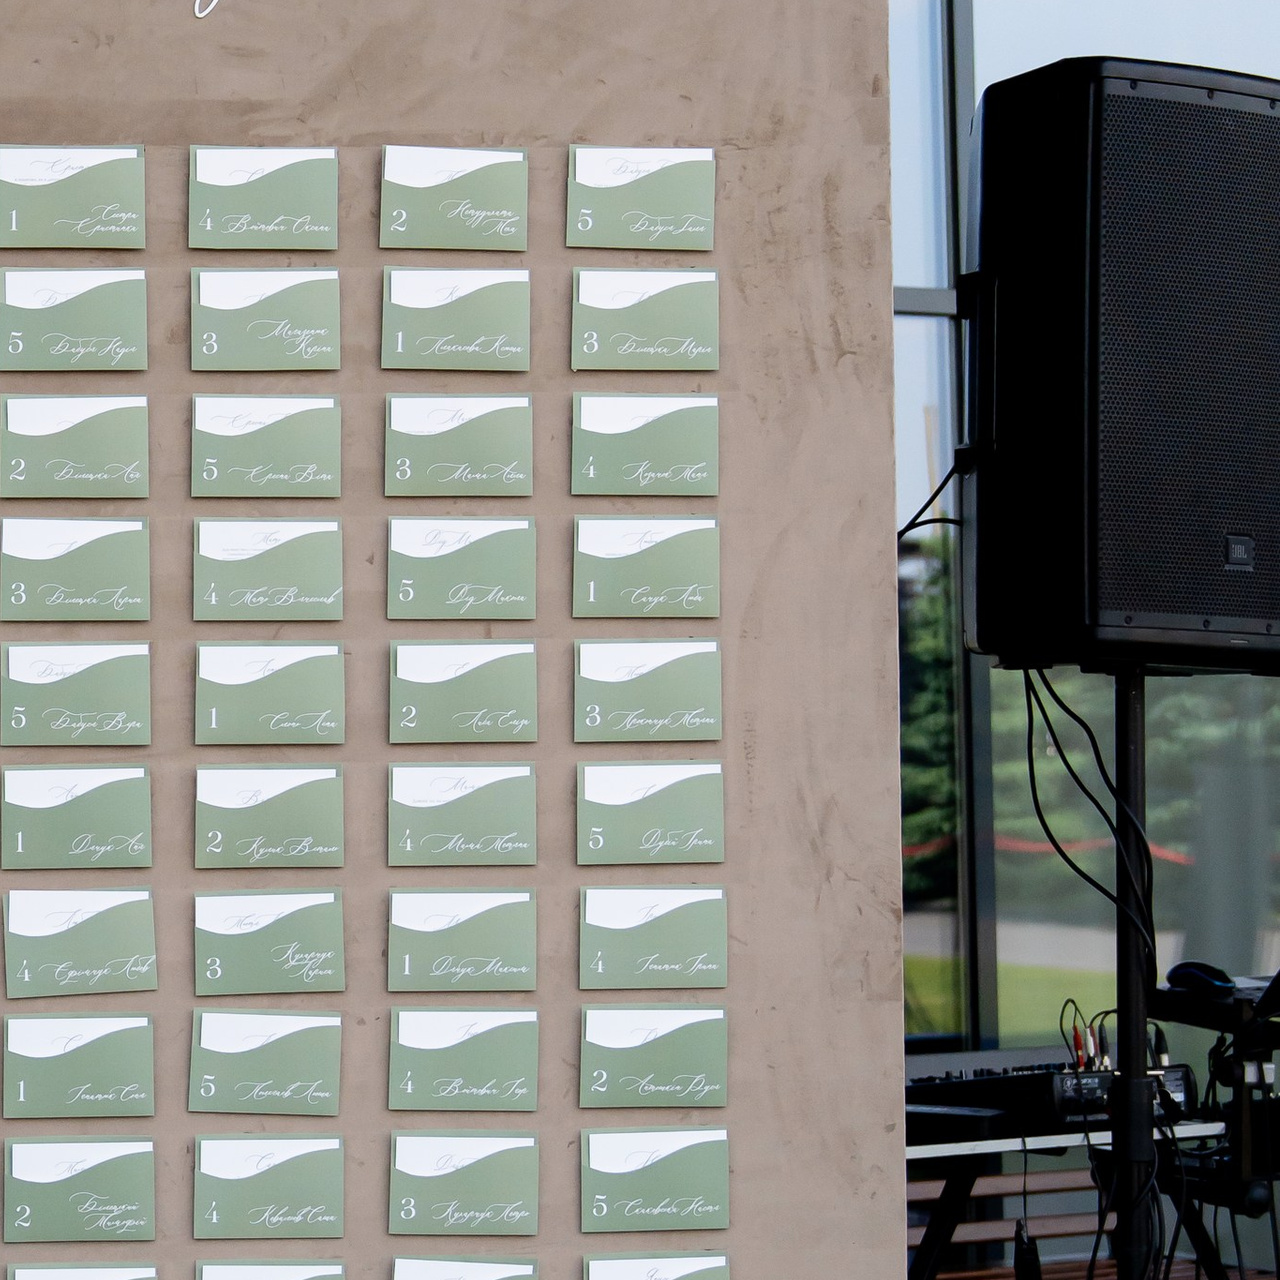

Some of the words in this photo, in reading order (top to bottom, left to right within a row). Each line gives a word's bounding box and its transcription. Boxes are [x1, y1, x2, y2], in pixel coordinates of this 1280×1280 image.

[9, 210, 18, 231] 1
[199, 209, 212, 231] 4
[391, 209, 407, 231] 2
[578, 209, 593, 231] 5
[8, 332, 23, 353] 5
[202, 332, 218, 354] 3
[395, 331, 404, 352] 1
[583, 331, 599, 352] 3
[10, 459, 25, 480] 2
[203, 459, 218, 480] 5
[396, 458, 411, 480] 3
[582, 456, 597, 479] 4
[1231, 544, 1247, 559] JBL
[11, 583, 26, 604] 3
[203, 583, 219, 606] 4
[399, 580, 414, 602] 5
[587, 581, 597, 603] 1
[11, 707, 27, 729] 5
[208, 708, 217, 728] 1
[401, 705, 418, 727] 2
[586, 704, 601, 727] 3
[15, 831, 24, 853] 1
[206, 830, 223, 852] 2
[398, 829, 414, 851] 4
[589, 827, 605, 849] 5
[16, 960, 32, 982] 4
[206, 957, 222, 979] 3
[403, 954, 411, 975] 1
[590, 951, 605, 973] 4
[200, 1075, 215, 1097] 5
[399, 1070, 414, 1093] 4
[591, 1069, 608, 1091] 2
[17, 1081, 25, 1102] 1
[15, 1205, 31, 1227] 2
[204, 1201, 220, 1223] 4
[400, 1198, 416, 1220] 3
[592, 1195, 608, 1217] 5
